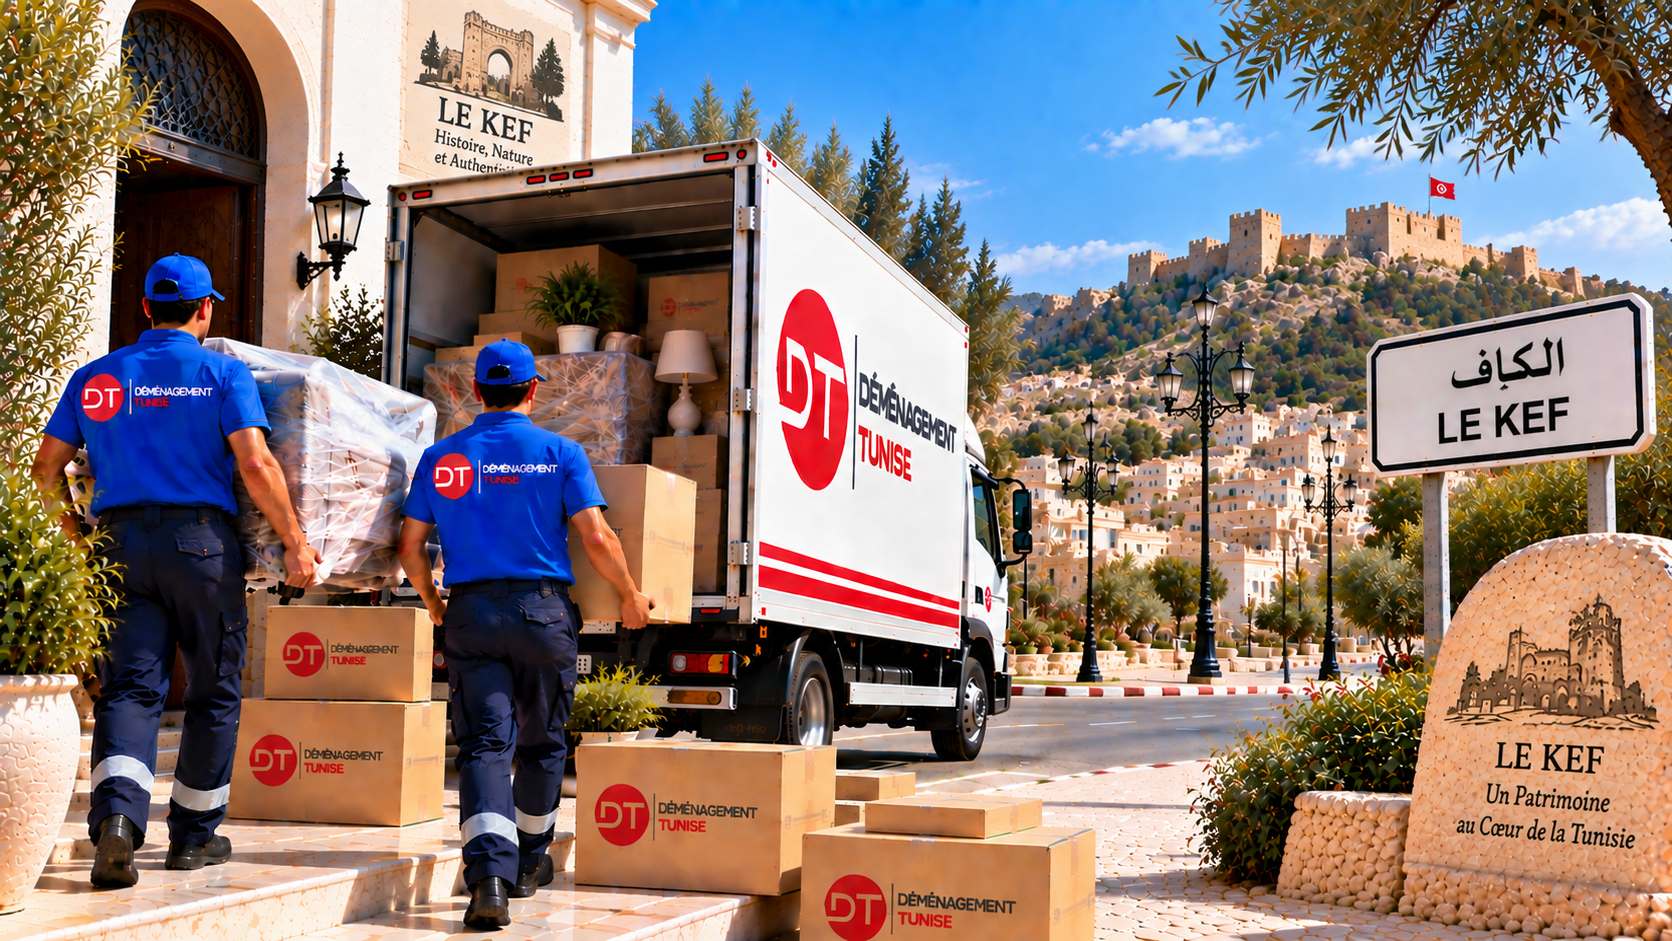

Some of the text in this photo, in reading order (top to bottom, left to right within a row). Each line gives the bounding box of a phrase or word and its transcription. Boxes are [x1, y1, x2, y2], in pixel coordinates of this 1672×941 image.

[438, 96, 534, 144] LE KEF
[434, 128, 534, 166] Histoire, Nature
[434, 153, 448, 165] et
[83, 388, 121, 409] DT
[779, 336, 846, 440] DT
[859, 371, 957, 454] DÉMÉNAGEMENT
[1438, 396, 1569, 444] LE KEF
[858, 424, 912, 482] TUNISE
[435, 466, 471, 487] DT
[283, 645, 322, 665] DT
[251, 749, 293, 771] DT
[304, 762, 344, 774] TUNISE
[1495, 742, 1605, 774] LE KEF
[1486, 783, 1611, 813] Un Patrimoine
[597, 801, 645, 829] DT
[658, 818, 706, 833] TUNISE
[1456, 815, 1636, 849] au Cœur de la Tunisie
[826, 892, 882, 925] DT
[897, 911, 953, 929] TUNISE
